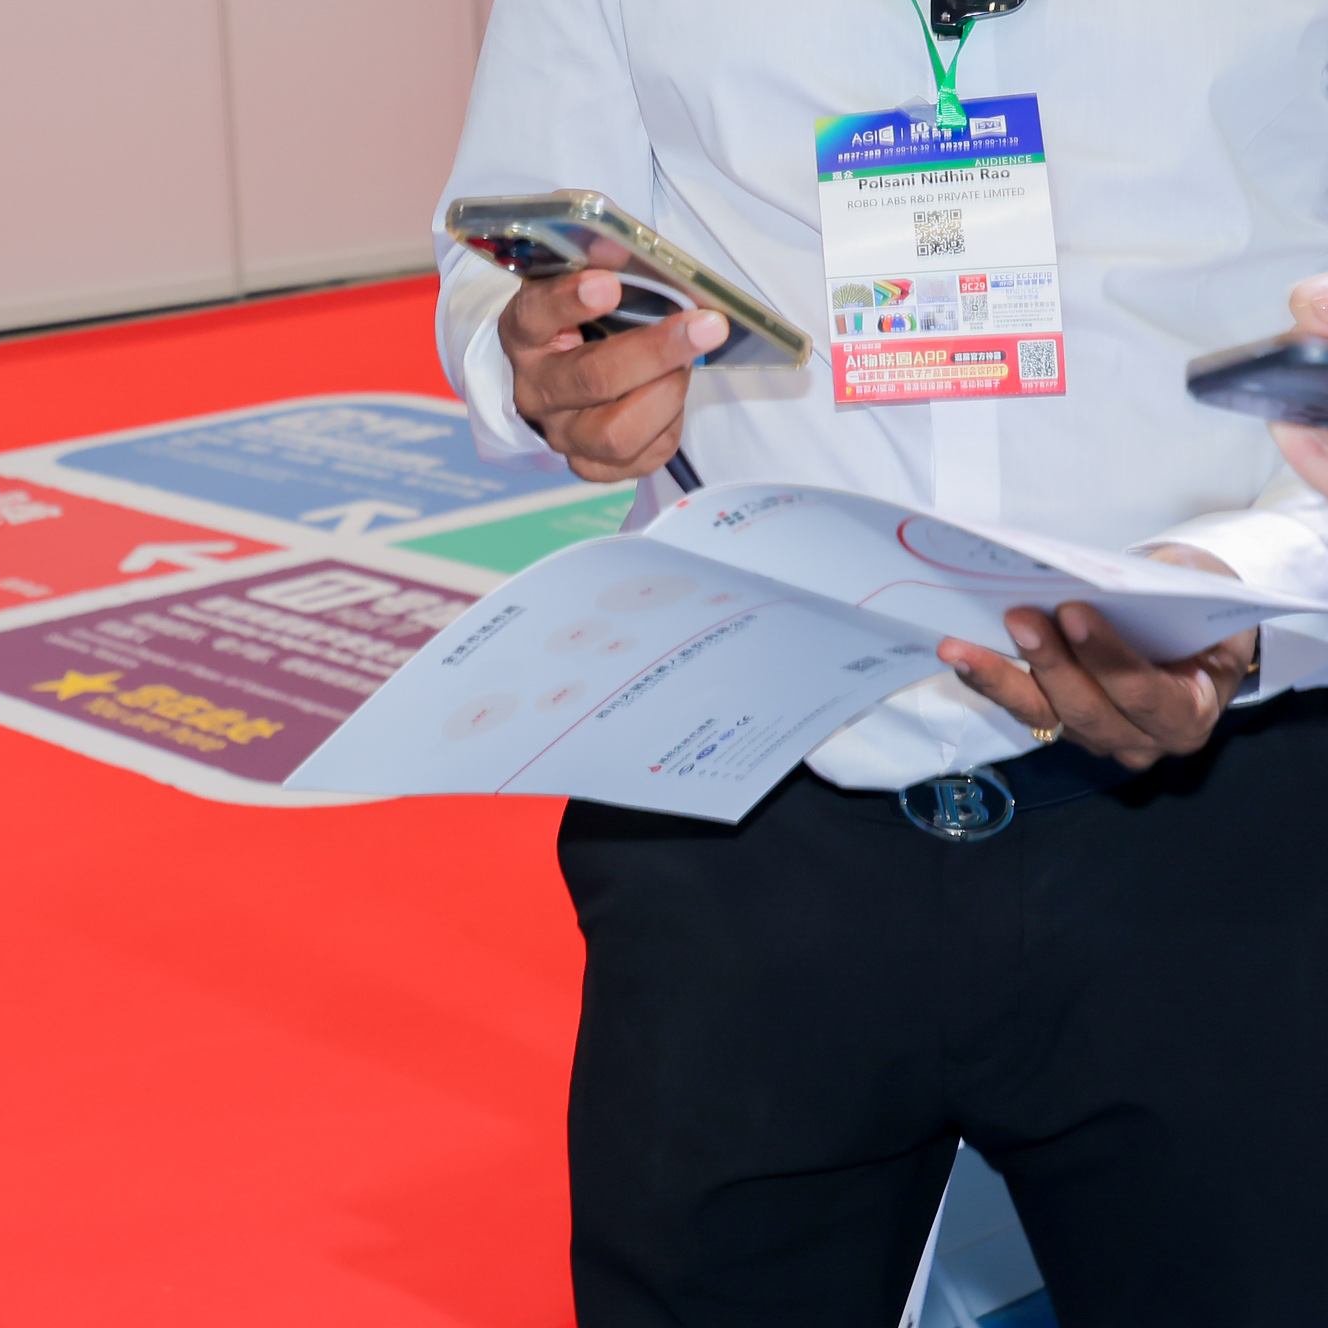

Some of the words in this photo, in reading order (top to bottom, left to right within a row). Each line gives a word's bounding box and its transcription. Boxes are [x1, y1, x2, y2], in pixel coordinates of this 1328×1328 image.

[975, 155, 1032, 167] AUDIENCE
[858, 175, 915, 190] Polsani
[921, 169, 975, 185] Nidhin
[981, 168, 1010, 180] Rao
[848, 198, 877, 209] ROBO
[882, 195, 906, 206] LABS
[910, 193, 934, 204] R&D
[938, 190, 979, 201] PRIVATE
[983, 187, 1025, 198] LIMITED
[961, 282, 985, 291] 9C29
[846, 350, 947, 369] AI物联圈APP
